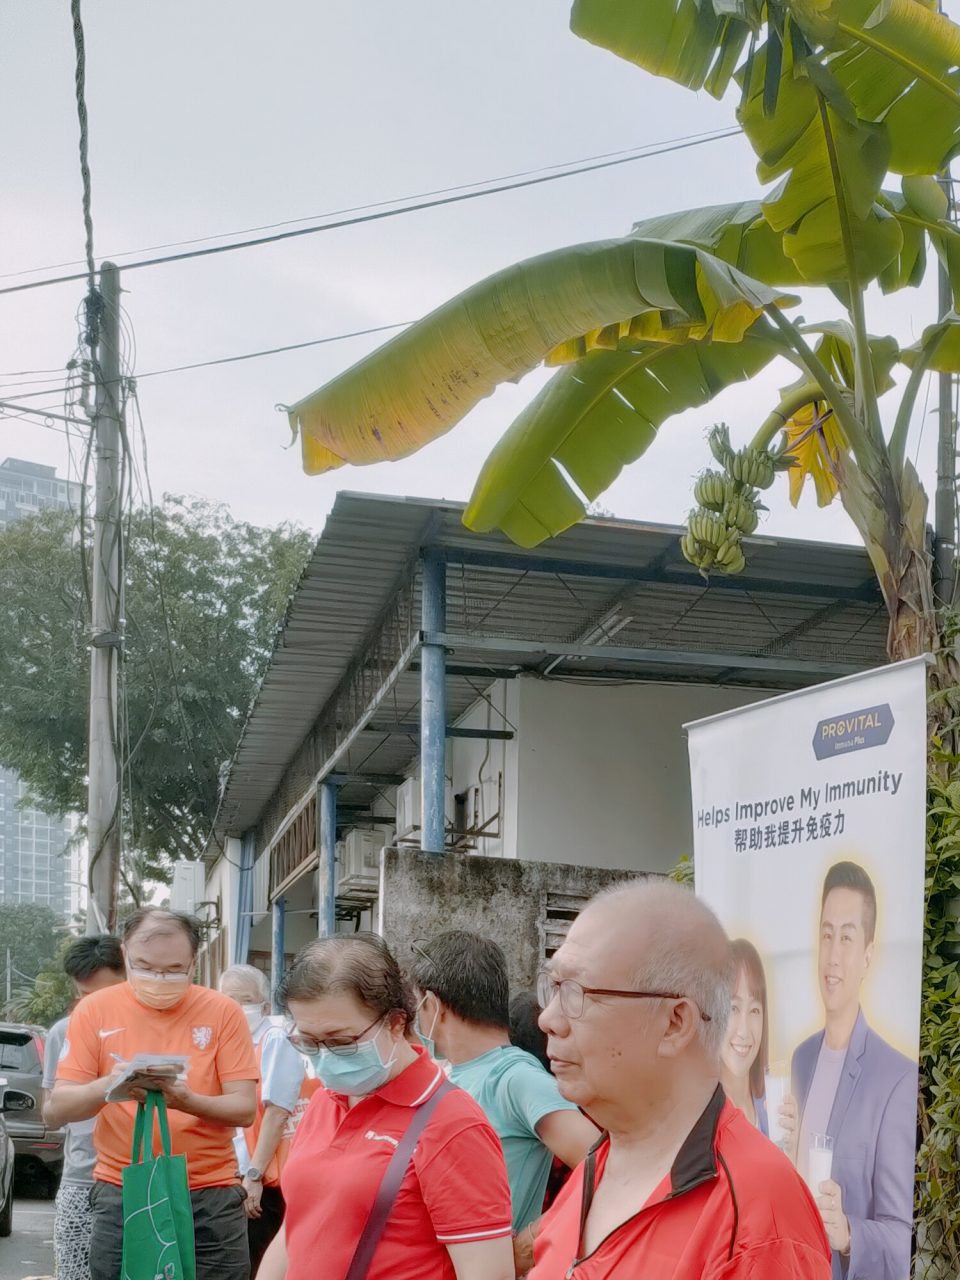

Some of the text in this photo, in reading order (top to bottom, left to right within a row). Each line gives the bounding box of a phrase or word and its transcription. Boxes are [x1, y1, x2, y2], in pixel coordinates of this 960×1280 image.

[822, 712, 882, 741] PROVITAL
[697, 770, 903, 829] Helps Improve My Immunity
[734, 808, 846, 854] 帮助我提升免疫力
